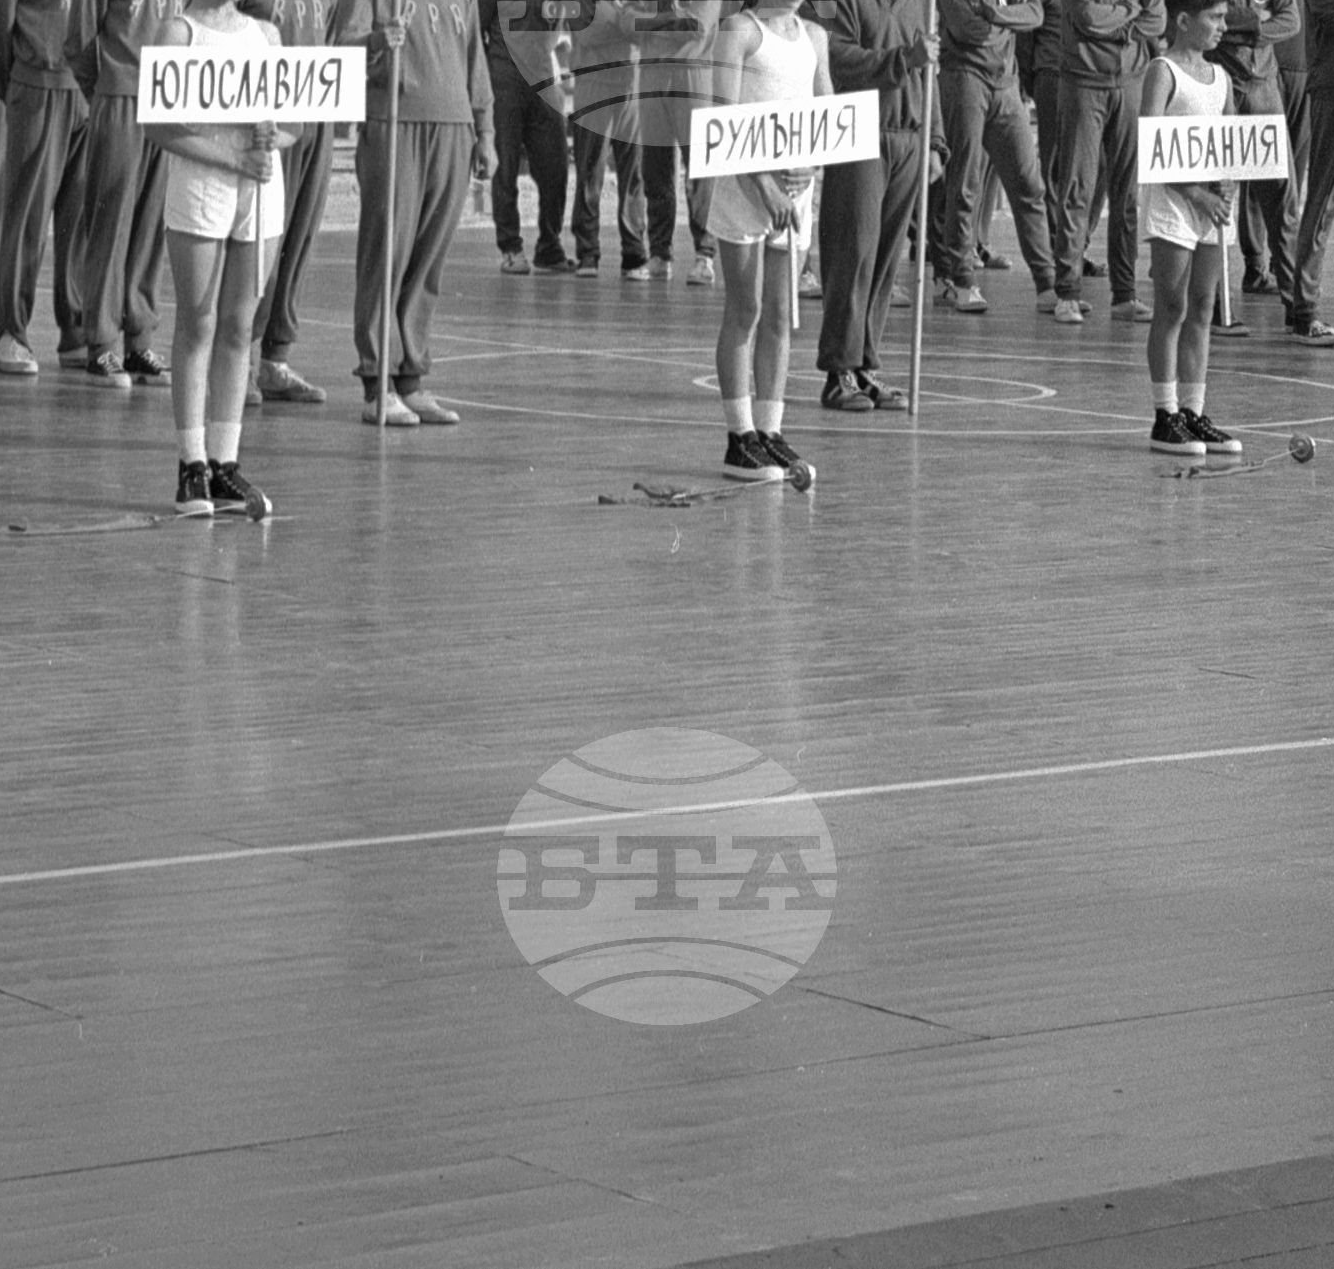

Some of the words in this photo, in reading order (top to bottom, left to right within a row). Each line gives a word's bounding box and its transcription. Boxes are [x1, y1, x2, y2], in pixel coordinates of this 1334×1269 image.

[150, 57, 342, 110] ЮГОСЛАВИЯ
[705, 104, 856, 166] РУМЪНИЯ
[1149, 123, 1279, 171] АЛБАНИЯ
